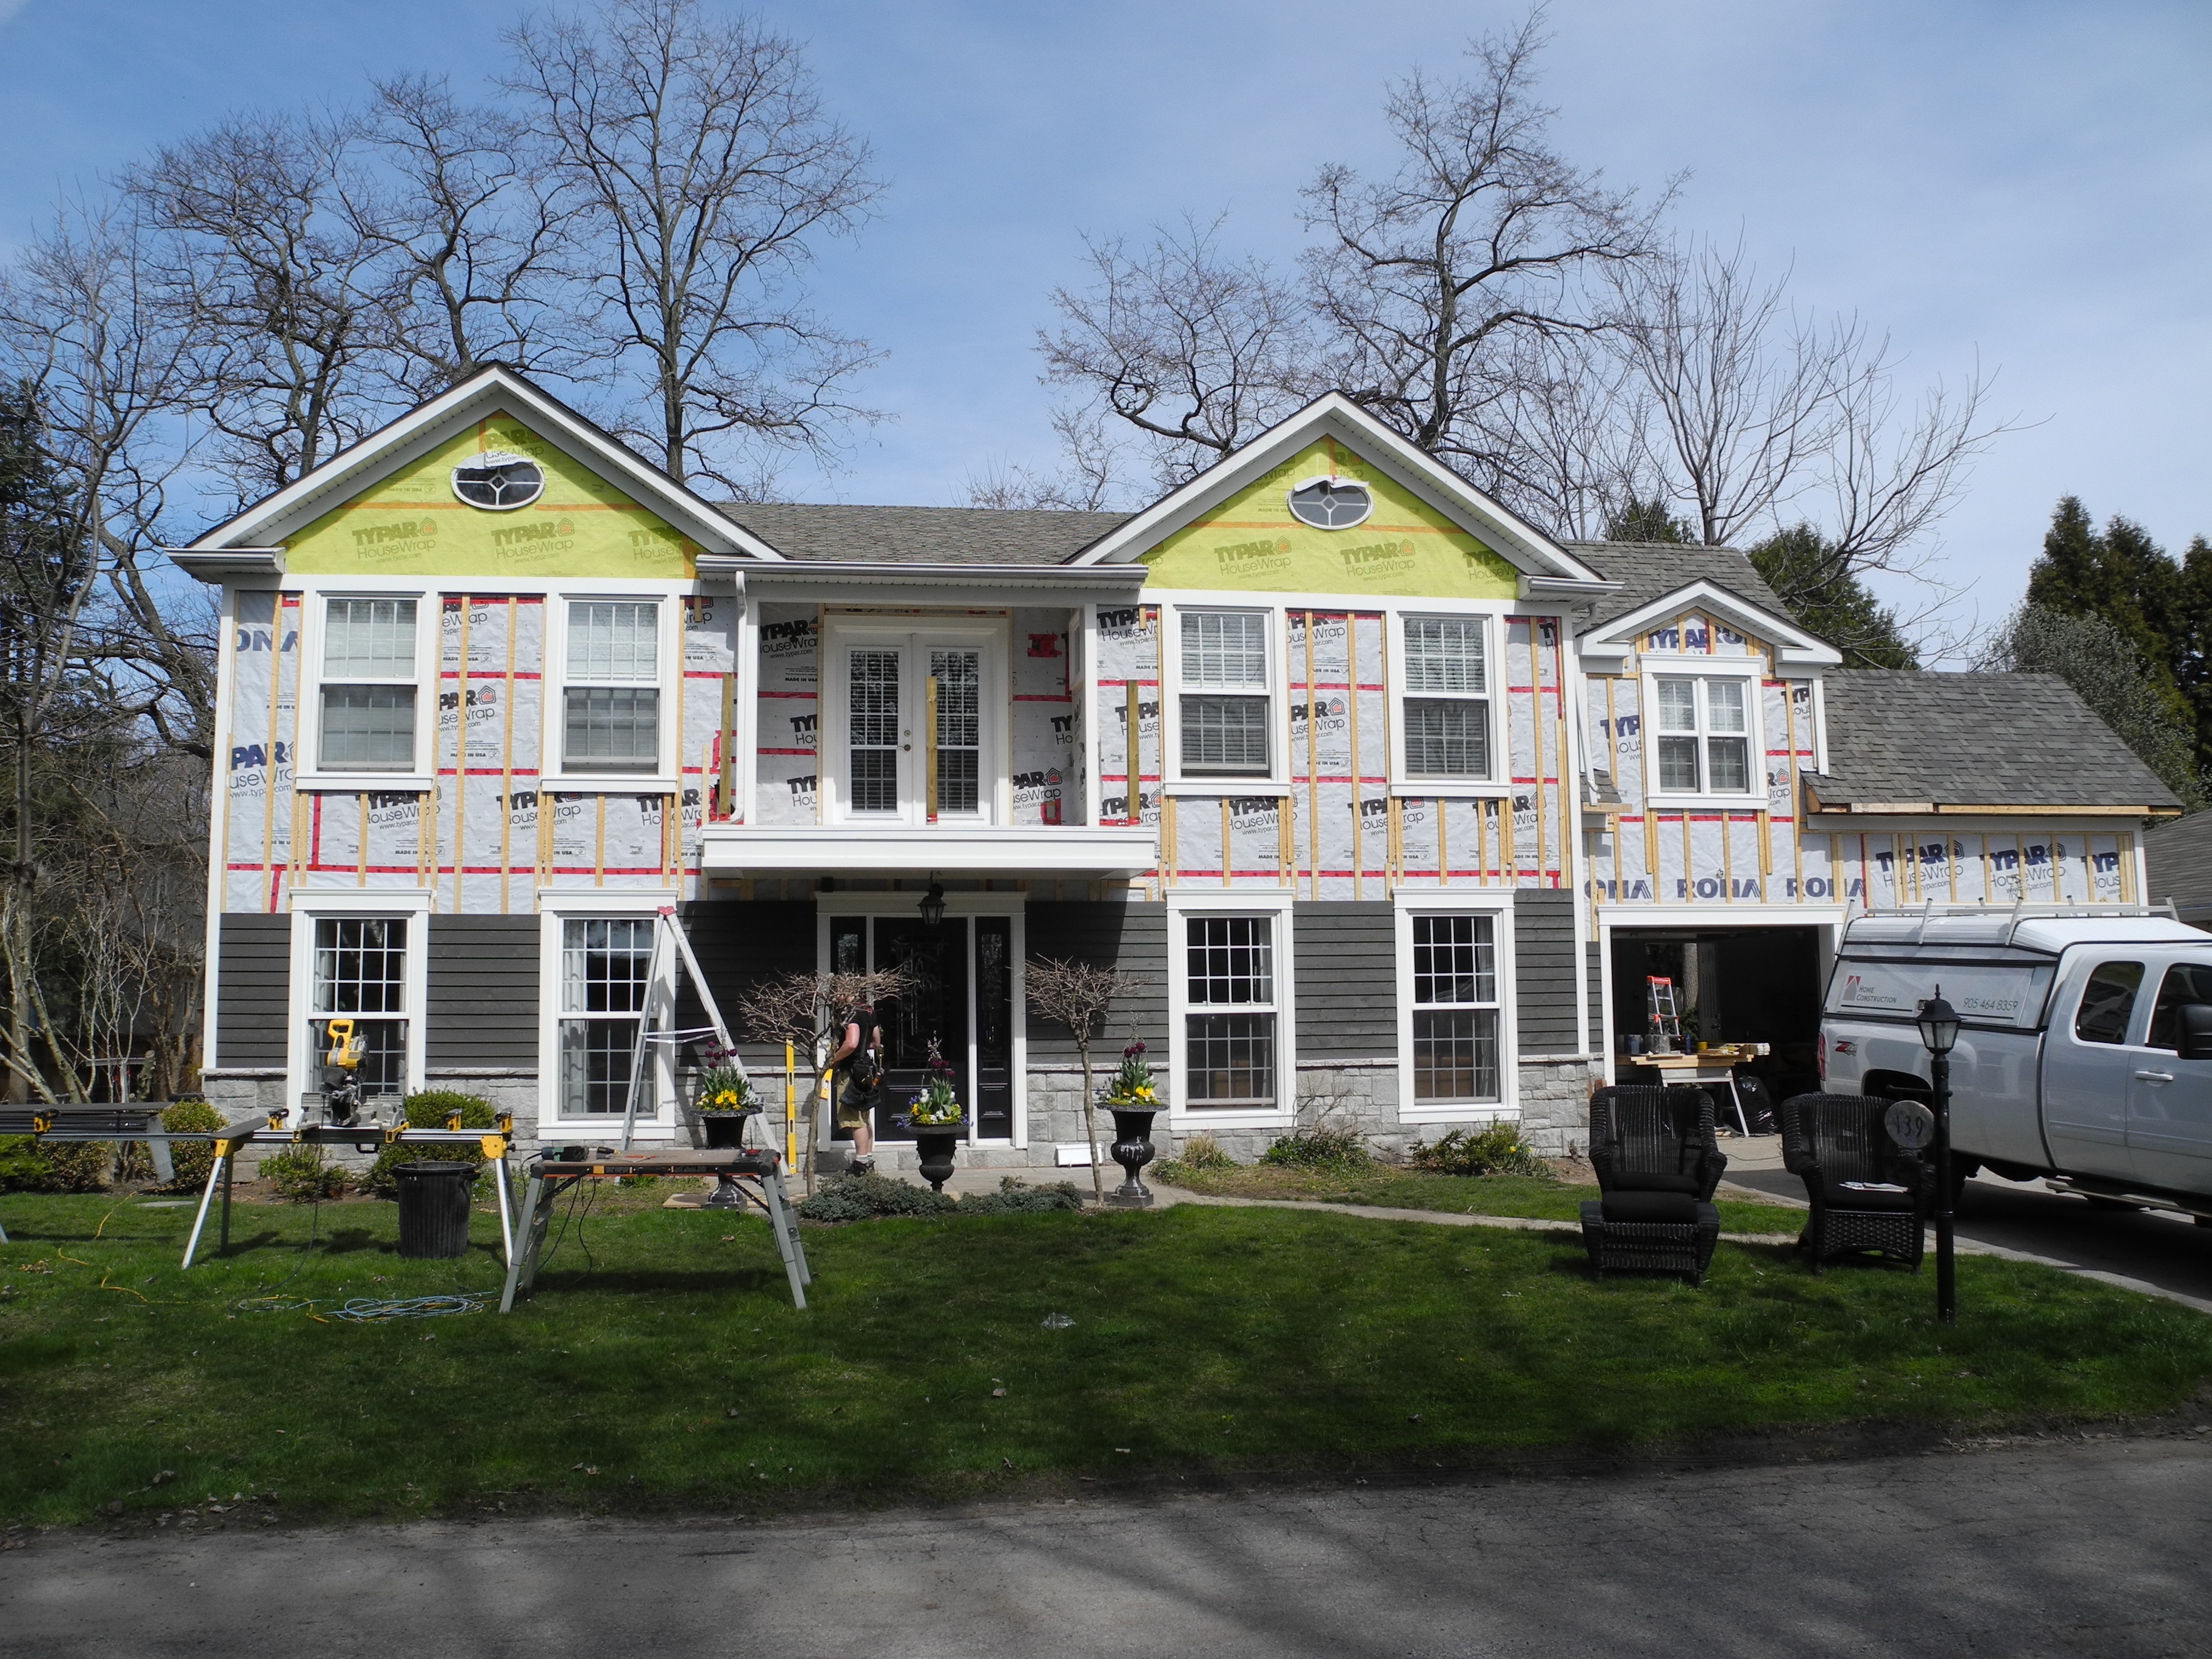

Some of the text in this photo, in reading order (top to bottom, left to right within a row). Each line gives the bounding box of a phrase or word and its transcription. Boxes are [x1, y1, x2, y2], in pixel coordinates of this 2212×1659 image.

[352, 521, 419, 546] TYPAR
[492, 522, 557, 546] TYPAR
[358, 540, 437, 559] HouseWrap
[377, 552, 422, 563] www.typar.com
[496, 539, 574, 560] HouseWrap
[1214, 540, 1274, 563] TYPAR
[1340, 543, 1398, 565] TYPAR
[1220, 556, 1292, 576] HouseWrap
[1346, 558, 1415, 577] HouseWrap
[770, 648, 813, 659] www.typar.com
[1678, 878, 1761, 899] RONA
[1856, 994, 1897, 1004] CONSTRUCTION
[1964, 997, 2018, 1011] 905 464 8359
[1897, 1114, 1923, 1138] 139
